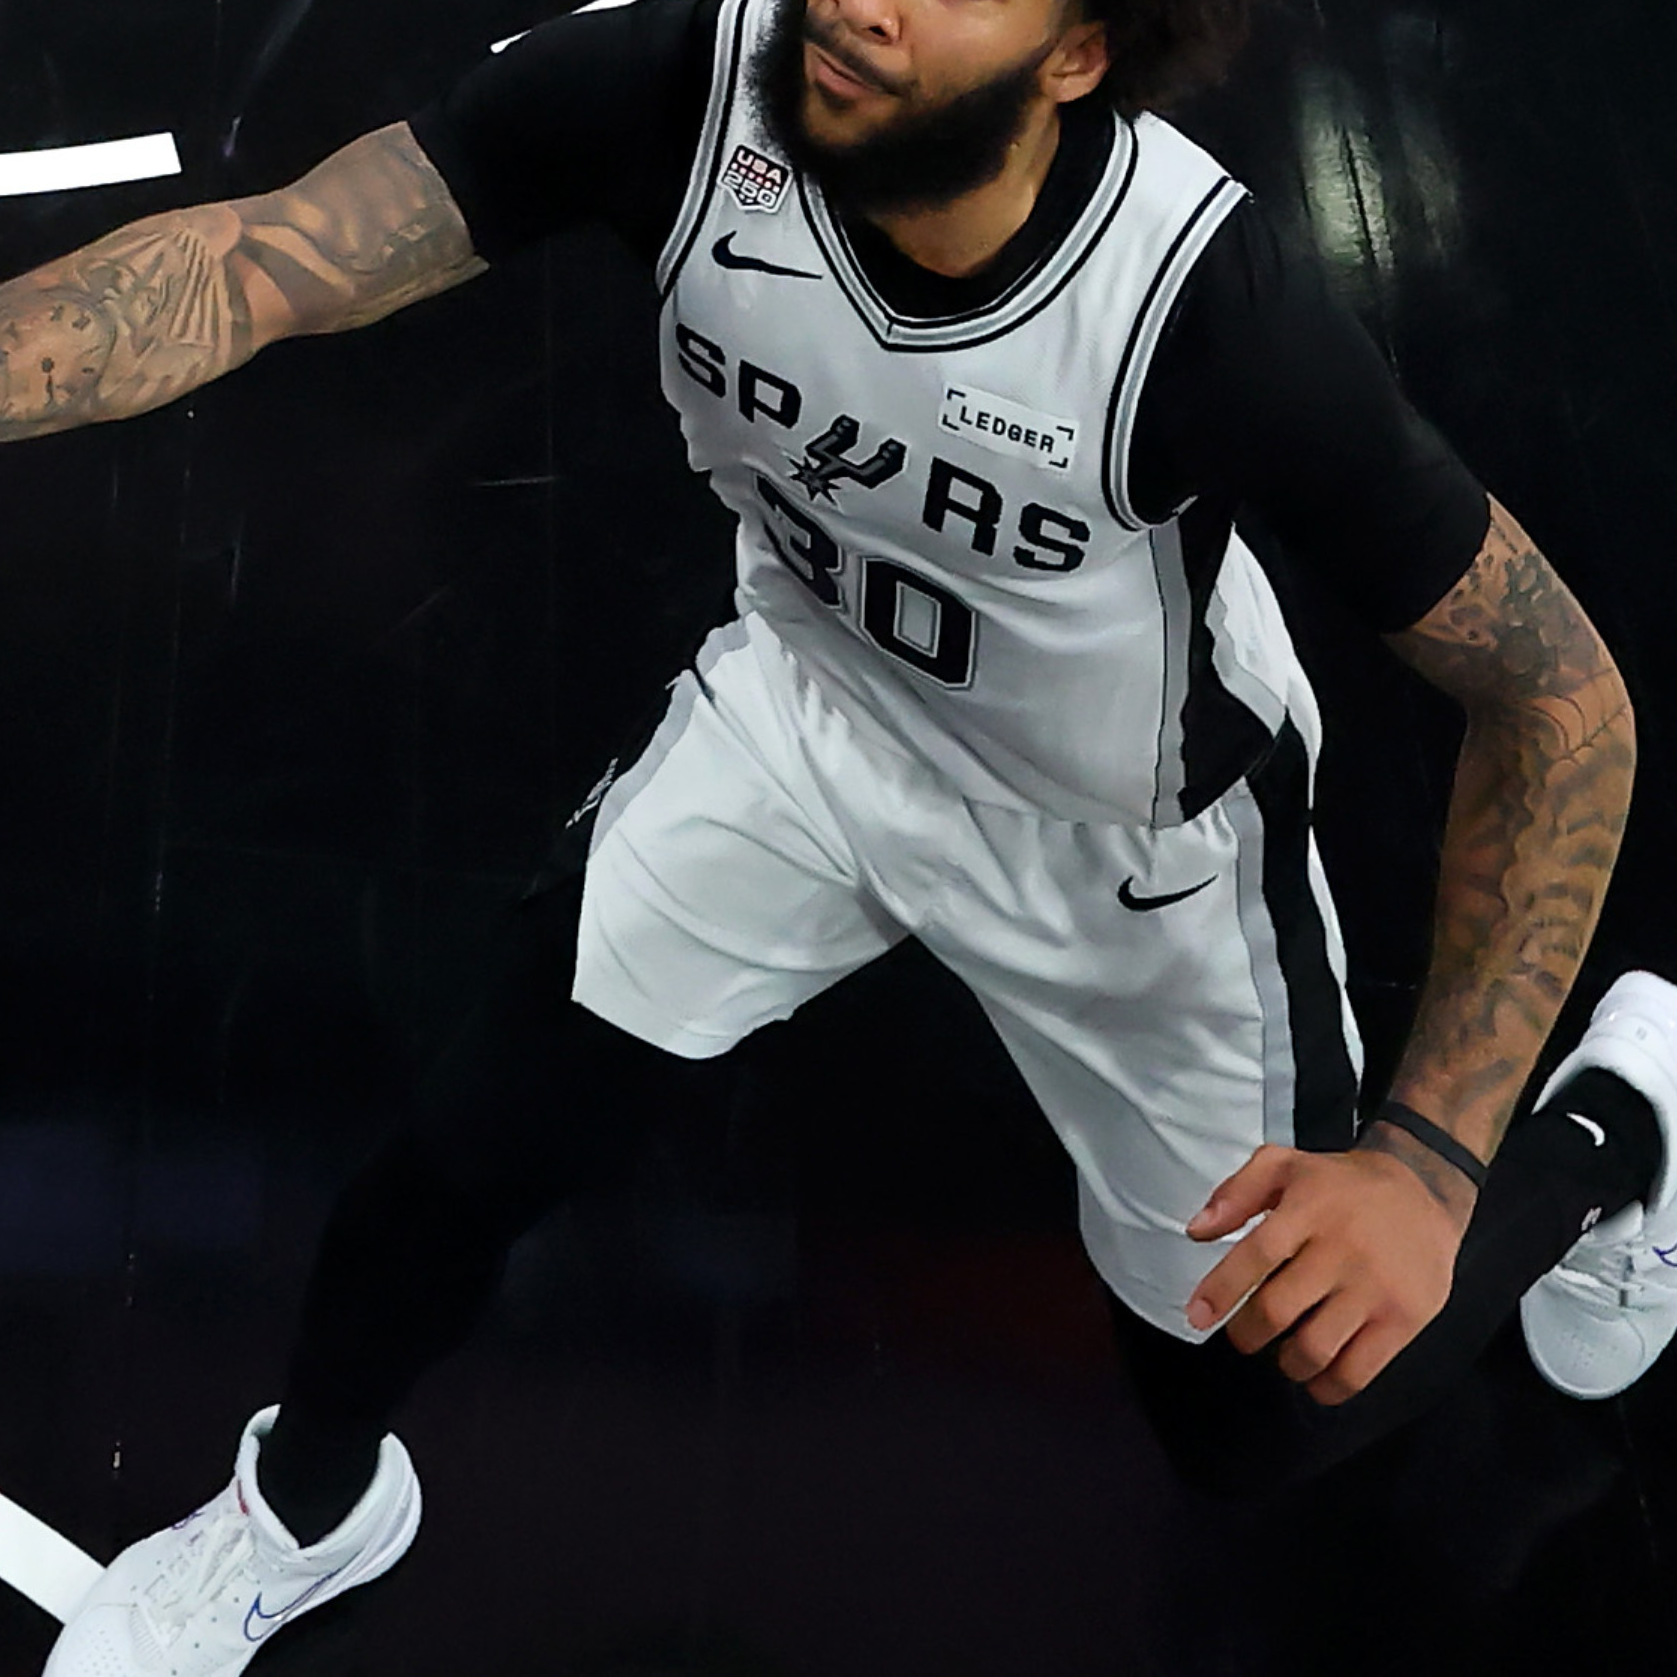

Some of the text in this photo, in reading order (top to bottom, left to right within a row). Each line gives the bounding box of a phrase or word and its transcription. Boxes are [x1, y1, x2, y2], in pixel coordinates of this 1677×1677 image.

[723, 170, 777, 207] 250
[736, 149, 783, 186] USA
[675, 322, 1092, 576] SPURS
[960, 404, 1056, 455] LEDGER
[755, 471, 978, 691] 30
